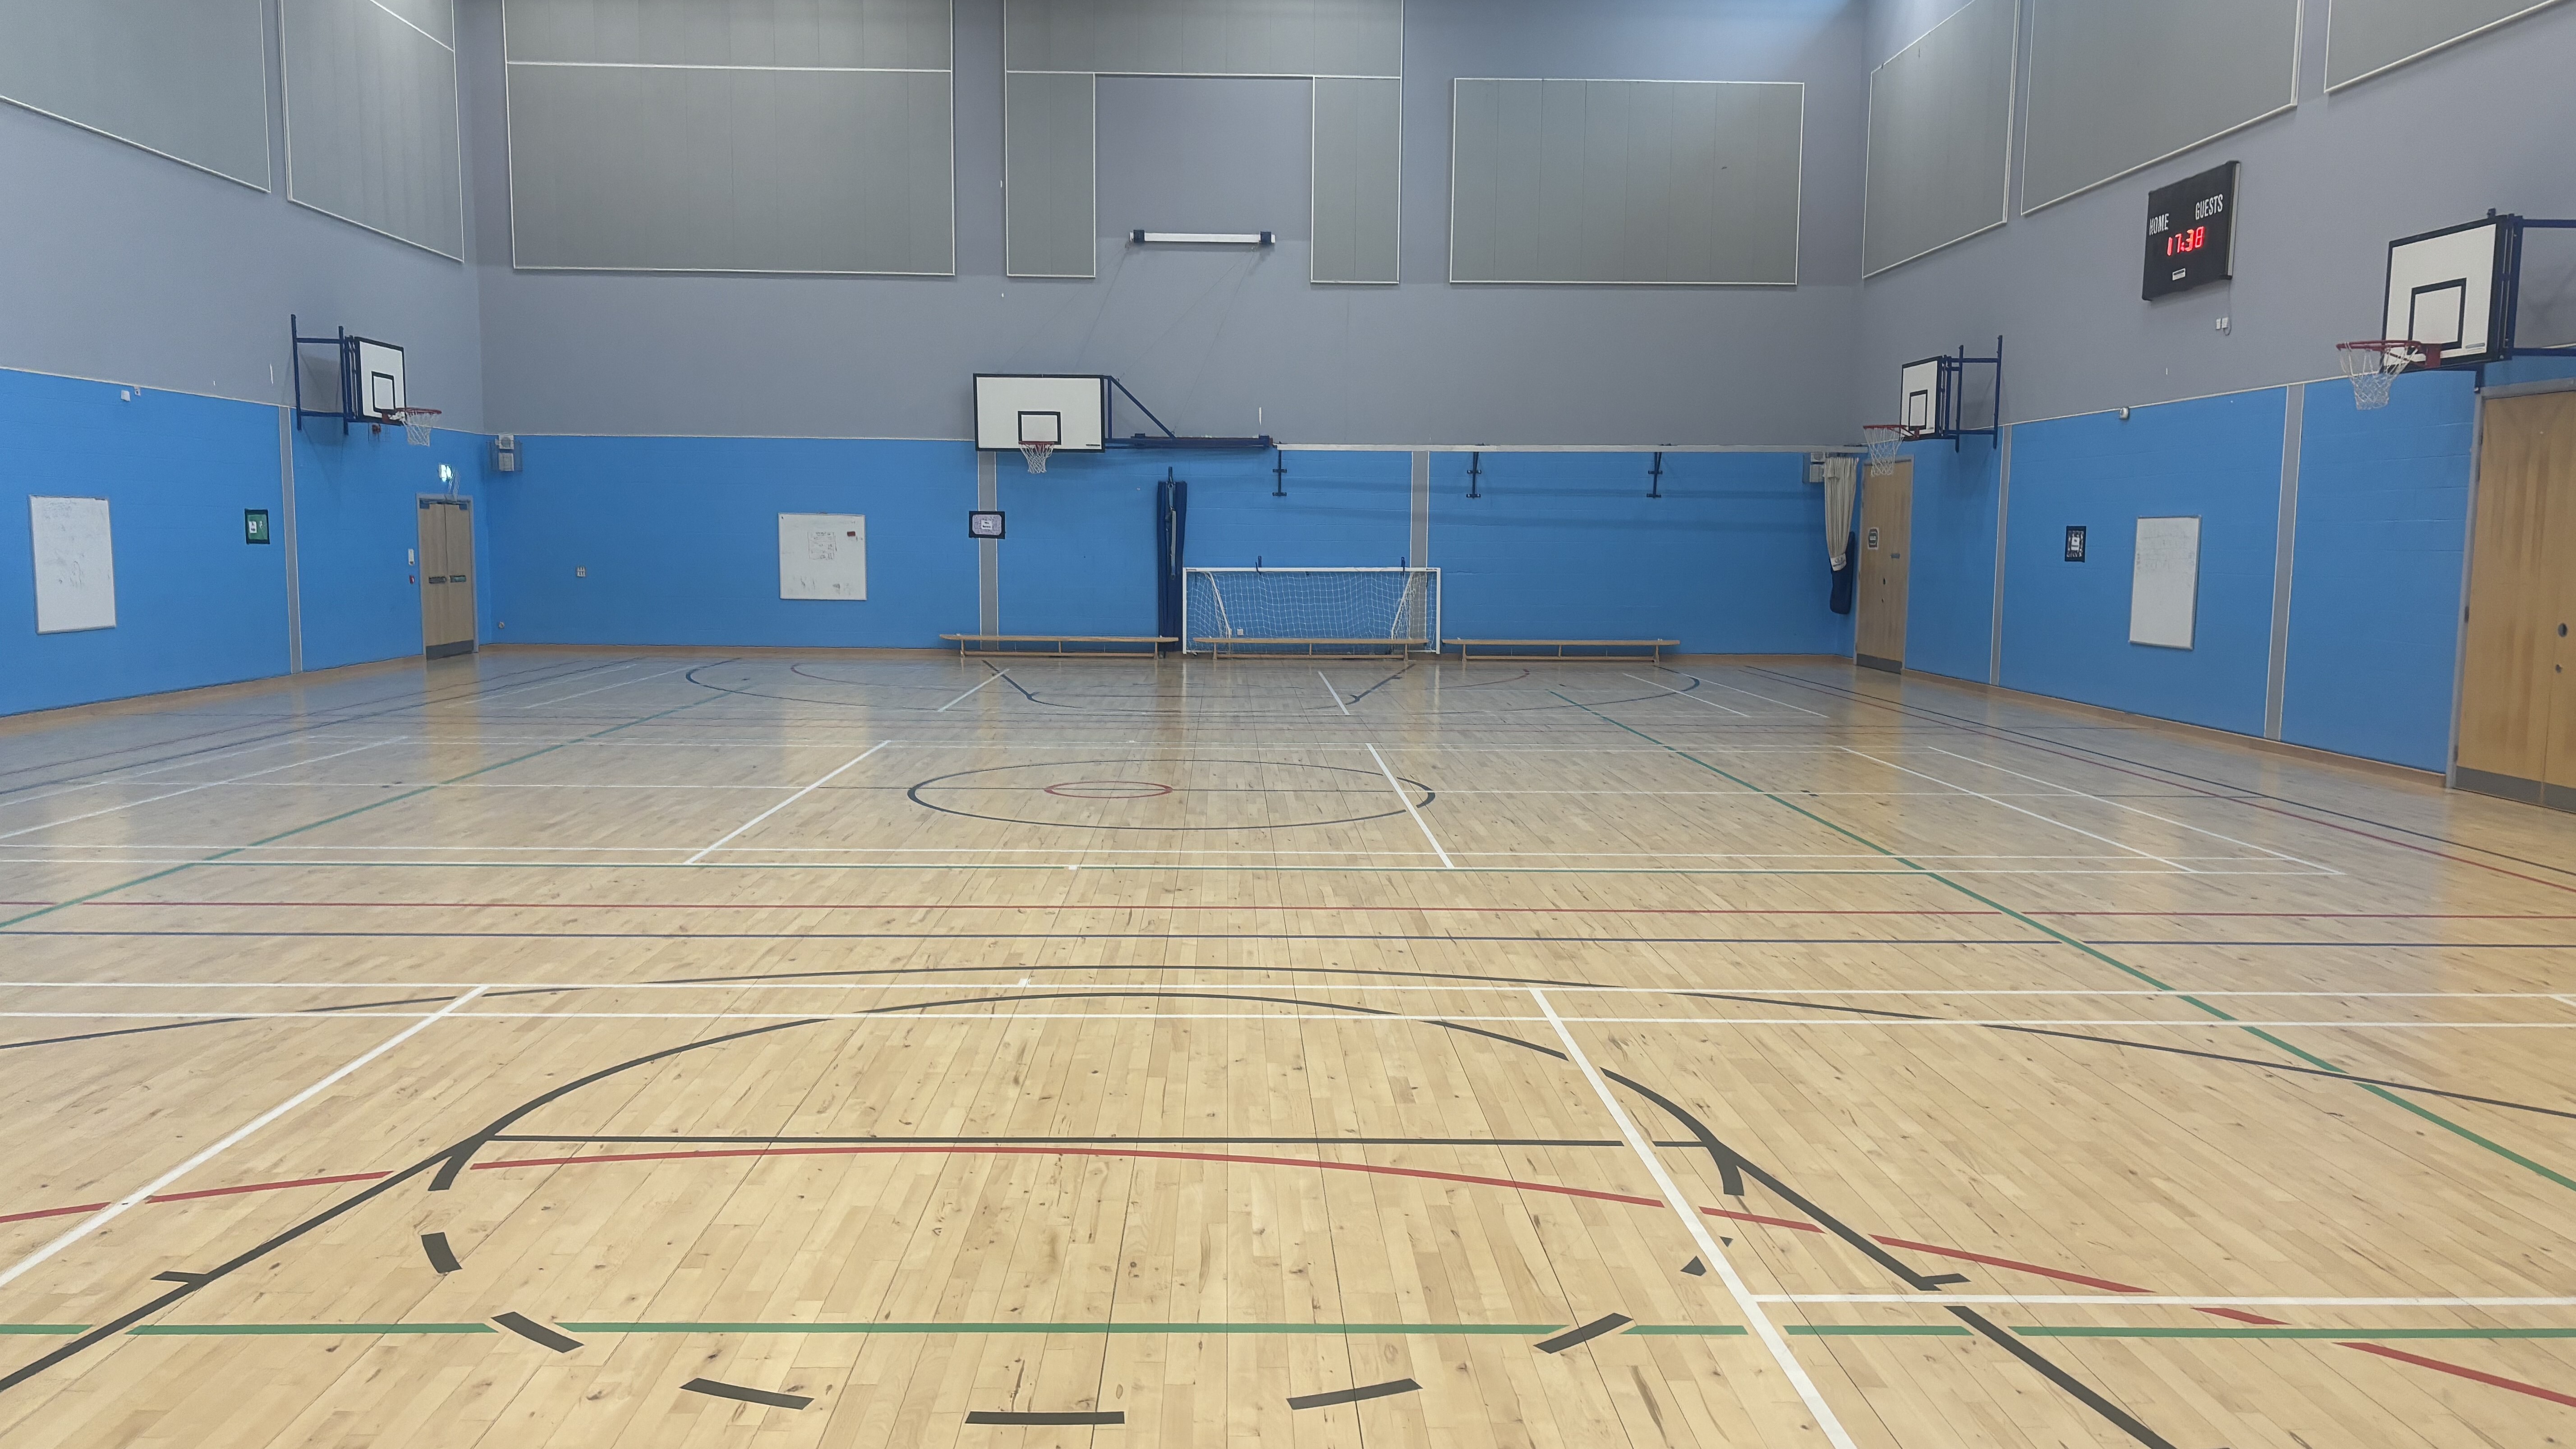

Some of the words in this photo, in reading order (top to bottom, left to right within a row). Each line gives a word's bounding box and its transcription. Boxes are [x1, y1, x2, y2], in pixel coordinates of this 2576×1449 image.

[2195, 194, 2222, 220] GUESTS
[2149, 213, 2169, 235] HOME
[2167, 226, 2204, 256] 17:38
